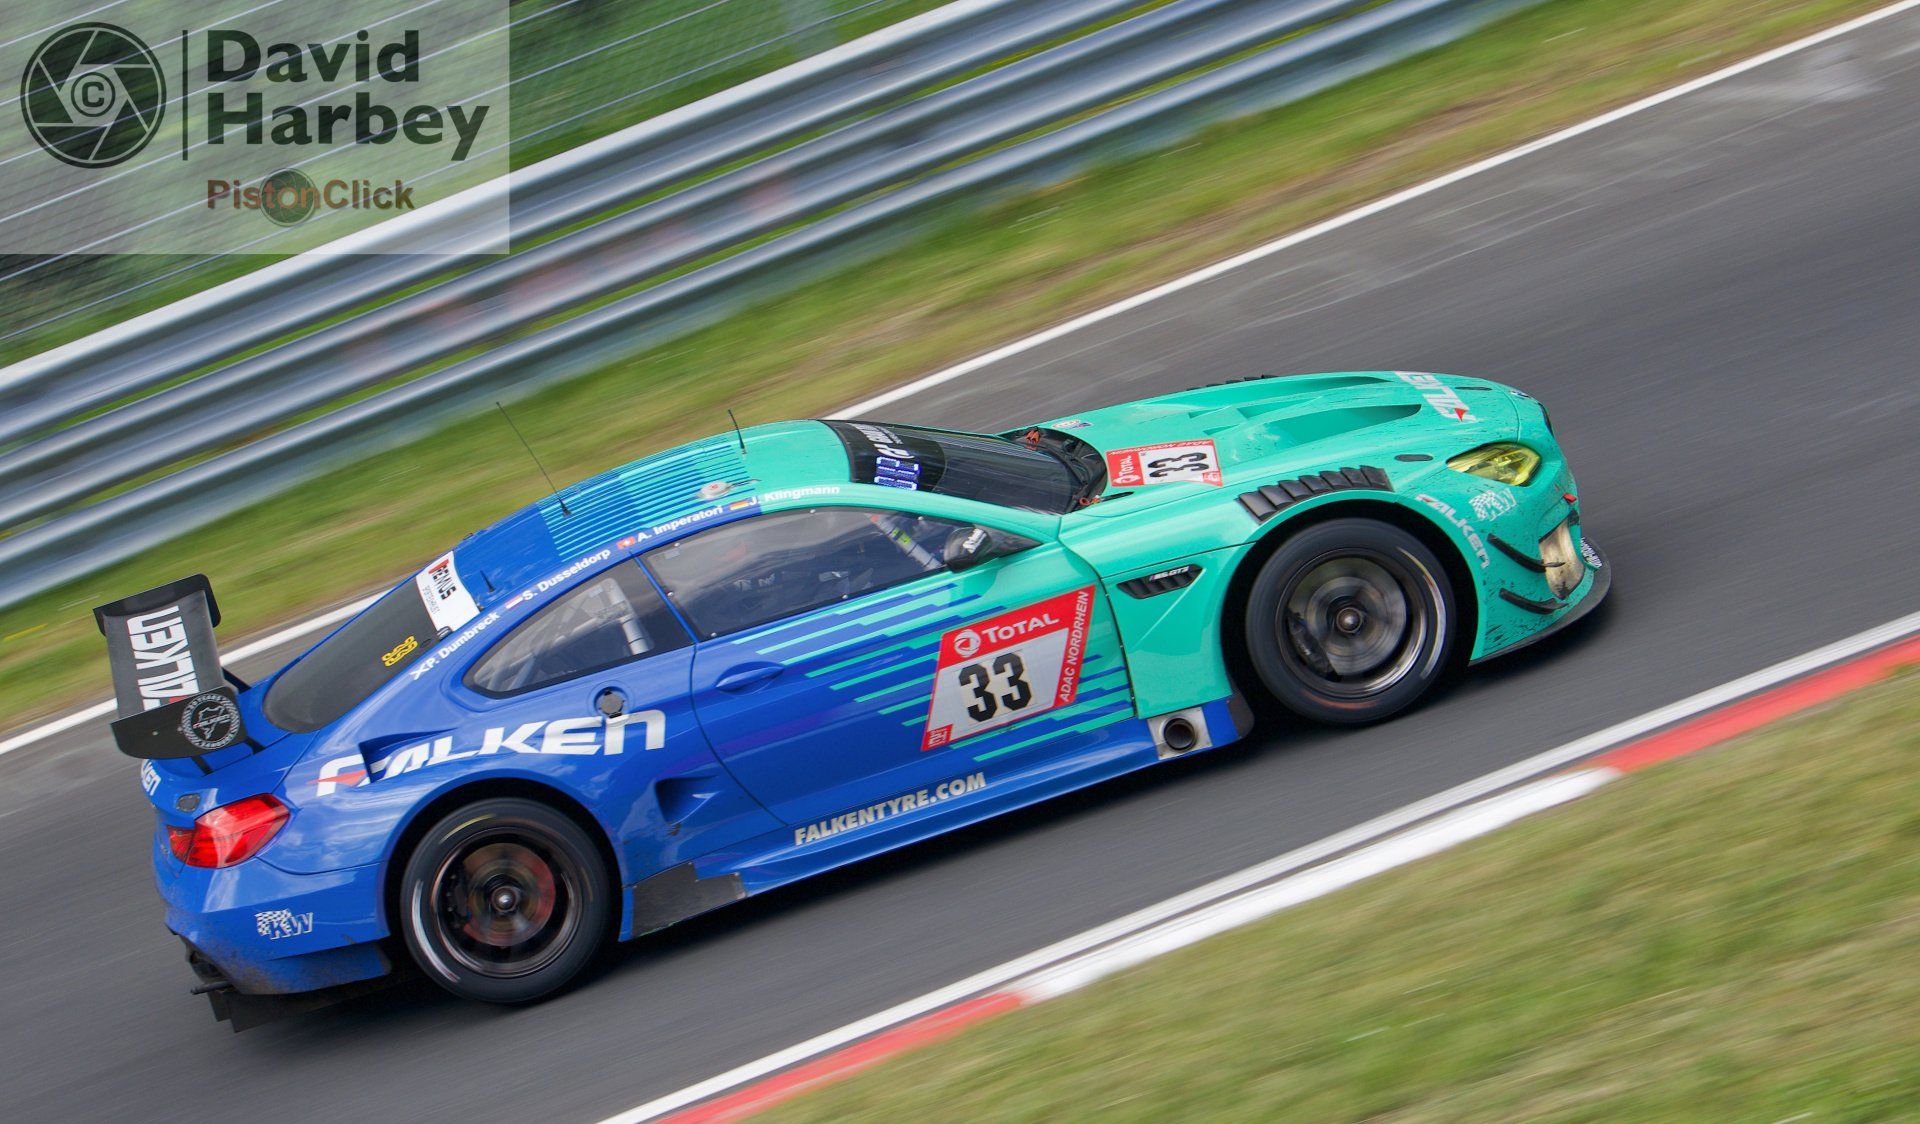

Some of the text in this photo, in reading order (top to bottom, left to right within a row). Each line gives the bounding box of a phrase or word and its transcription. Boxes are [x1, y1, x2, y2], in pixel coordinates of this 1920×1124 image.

[1148, 452, 1209, 477] 33
[763, 486, 840, 502] Klingmann
[637, 505, 723, 542] A. Imperatori
[1416, 494, 1490, 569] FALKEN
[428, 559, 456, 600] REMUS
[522, 549, 611, 602] S. Dusseldorp
[438, 612, 500, 659] Dumbreck
[982, 613, 1059, 643] TOTAL
[1060, 591, 1089, 701] ADAC NORDRHEIN
[958, 653, 1032, 722] 33
[307, 710, 665, 797] FALKEN
[794, 772, 986, 845] FALKENTYRE.COM
